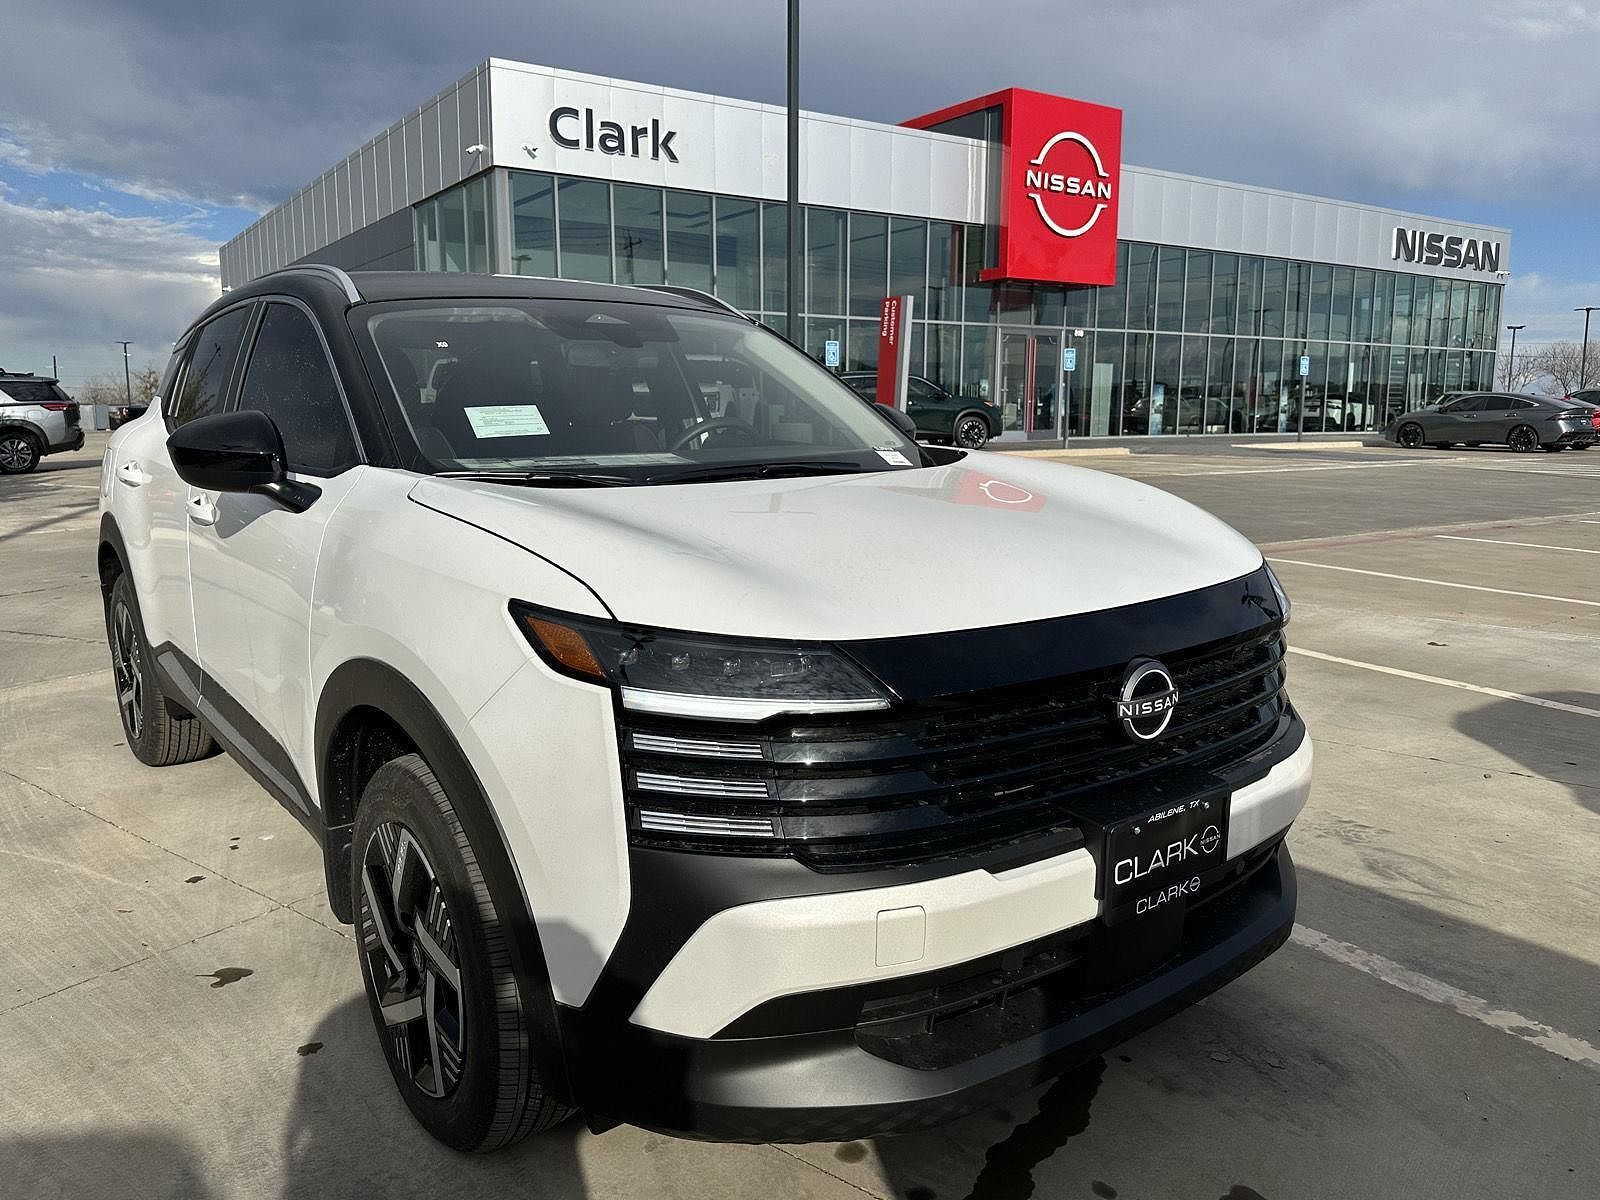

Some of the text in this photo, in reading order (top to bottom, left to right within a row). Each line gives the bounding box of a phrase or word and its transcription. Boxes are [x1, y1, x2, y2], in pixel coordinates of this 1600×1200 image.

[548, 106, 679, 164] Clark
[1026, 169, 1112, 200] NISSAN
[1392, 227, 1501, 273] NISSAN
[881, 301, 890, 337] Parking
[889, 300, 897, 346] Customer
[1119, 691, 1179, 717] NISSAN
[1147, 799, 1201, 824] ABILENE, TX
[1114, 833, 1199, 885] CLARK
[1136, 880, 1189, 915] CLARK
